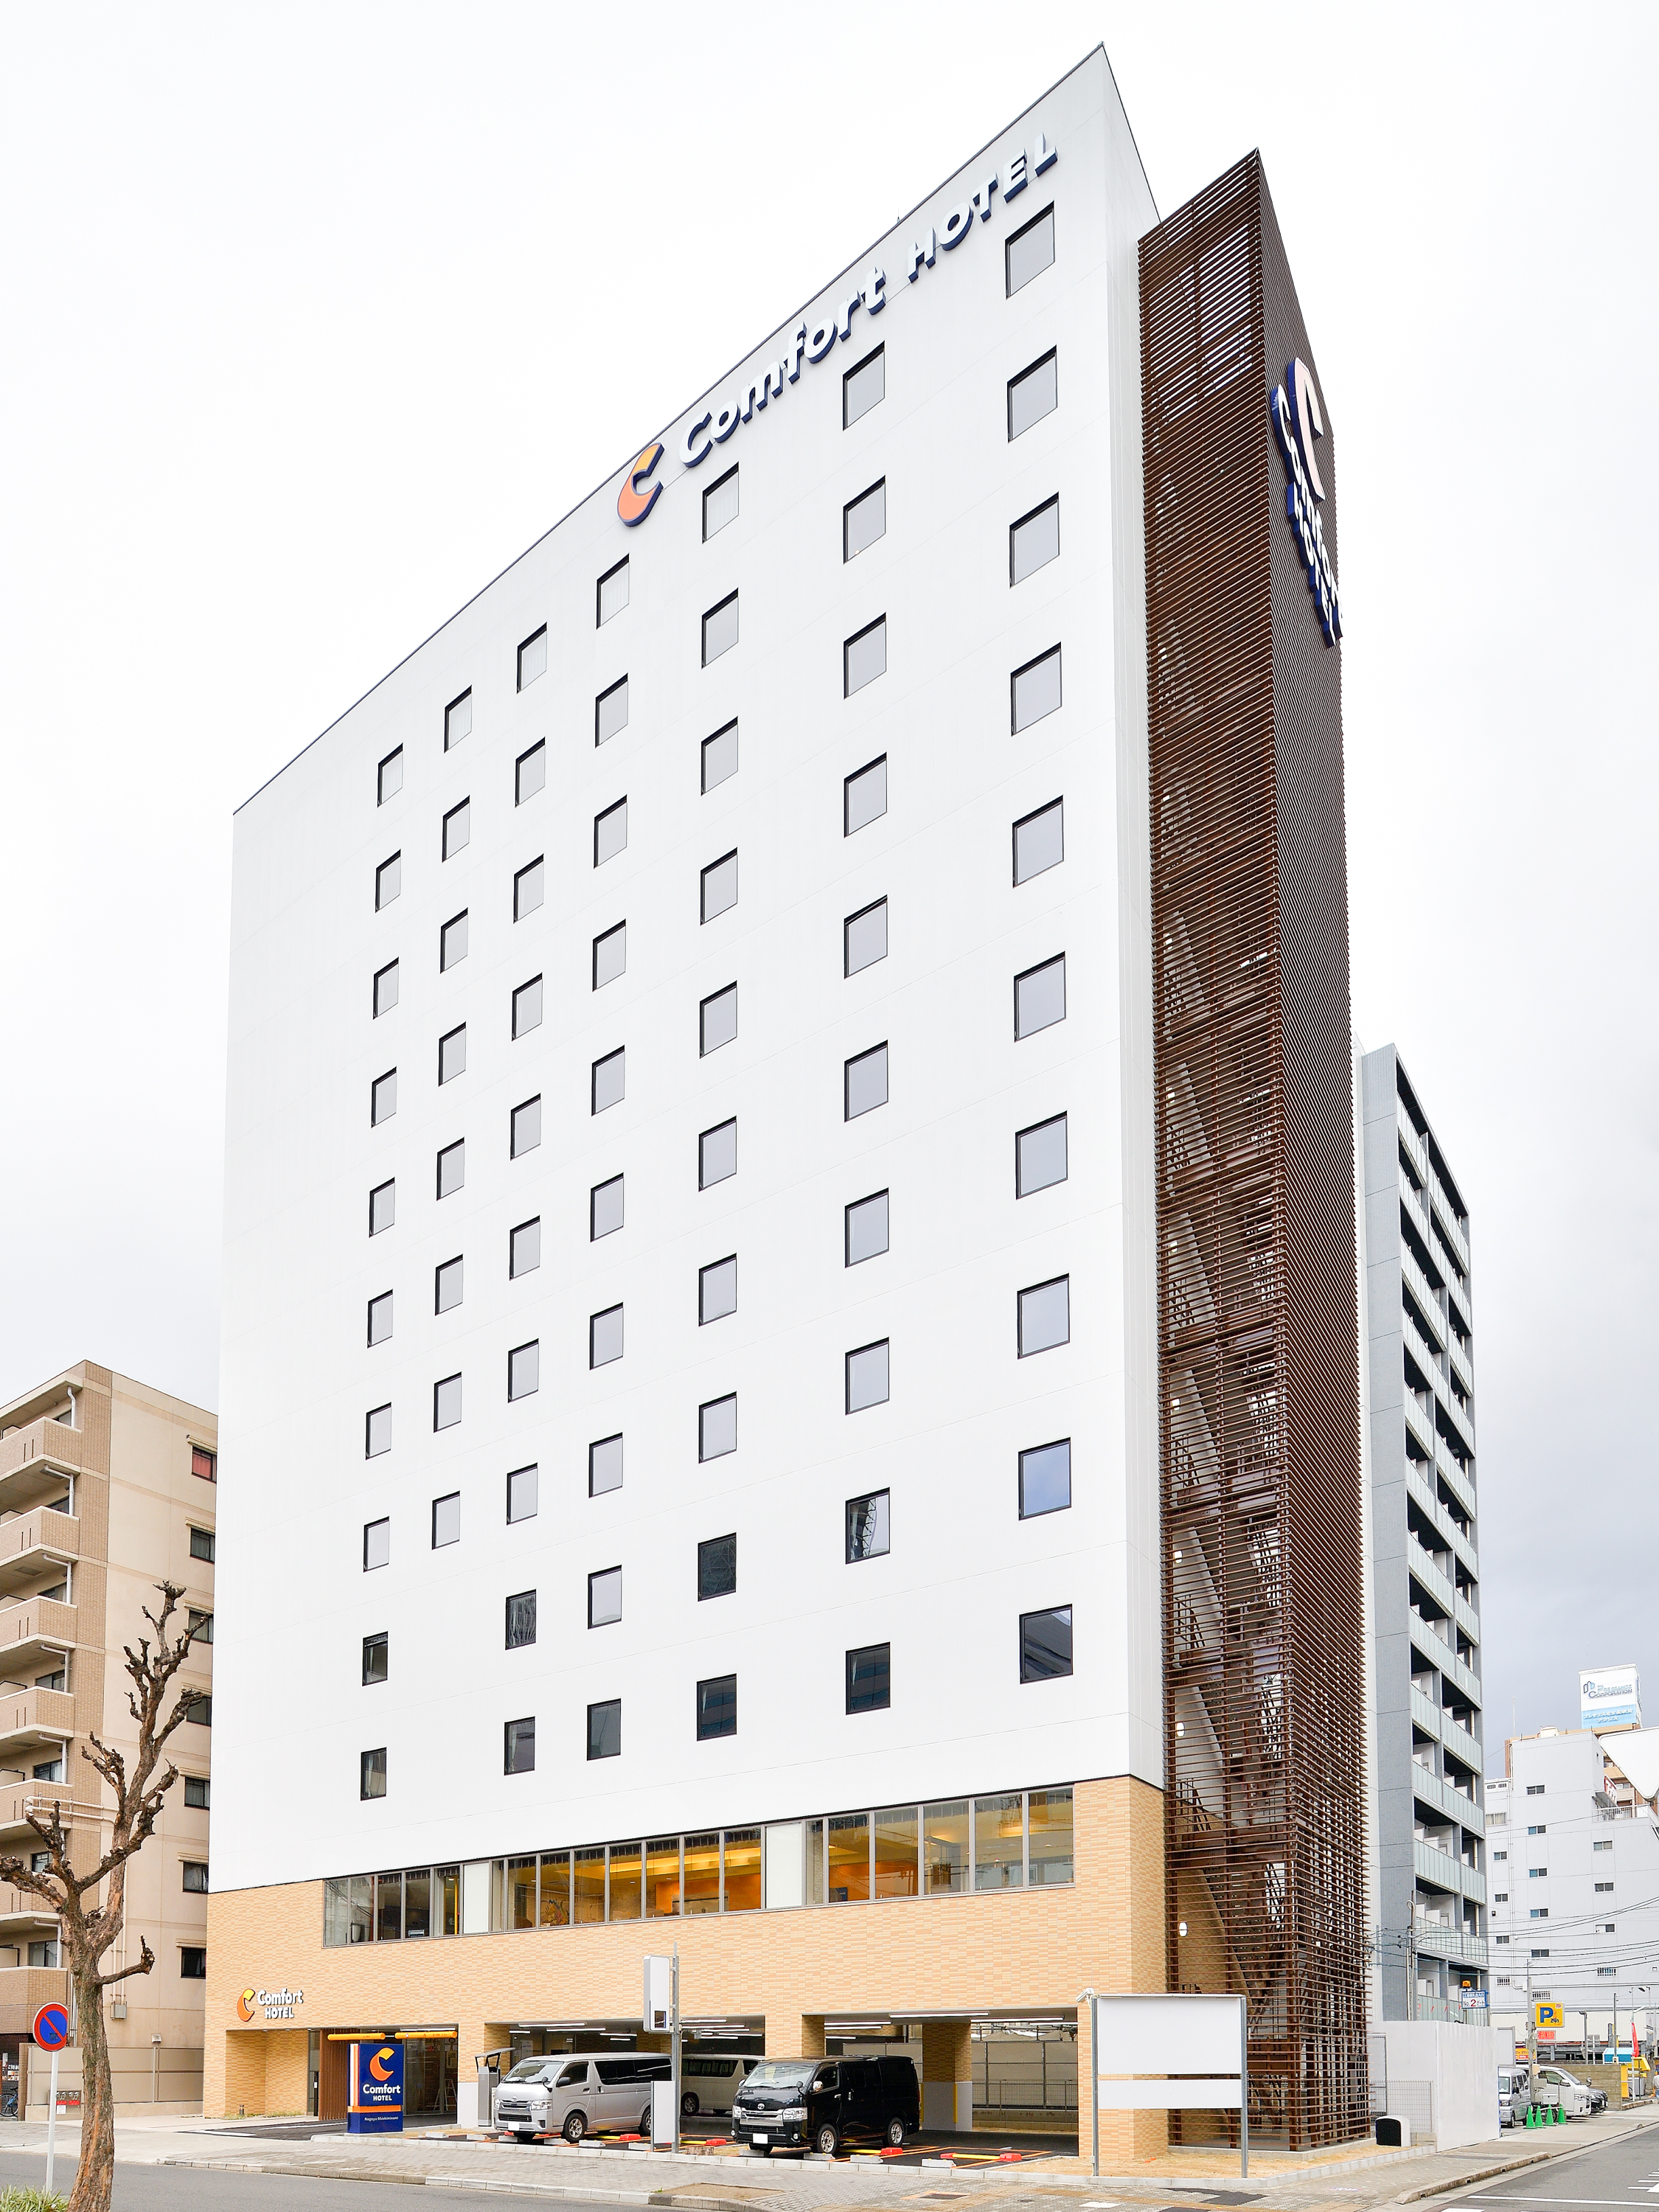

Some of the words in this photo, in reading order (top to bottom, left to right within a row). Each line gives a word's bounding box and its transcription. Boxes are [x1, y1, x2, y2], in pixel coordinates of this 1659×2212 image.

[679, 265, 886, 469] Comfort
[908, 132, 1058, 284] HOTEL
[1288, 481, 1336, 647] HOTEL
[257, 1987, 304, 2006] Comfort
[1470, 1999, 1477, 2007] 2
[265, 2006, 294, 2019] HOTEL
[1540, 2007, 1554, 2023] P
[363, 2083, 401, 2094] Comfort
